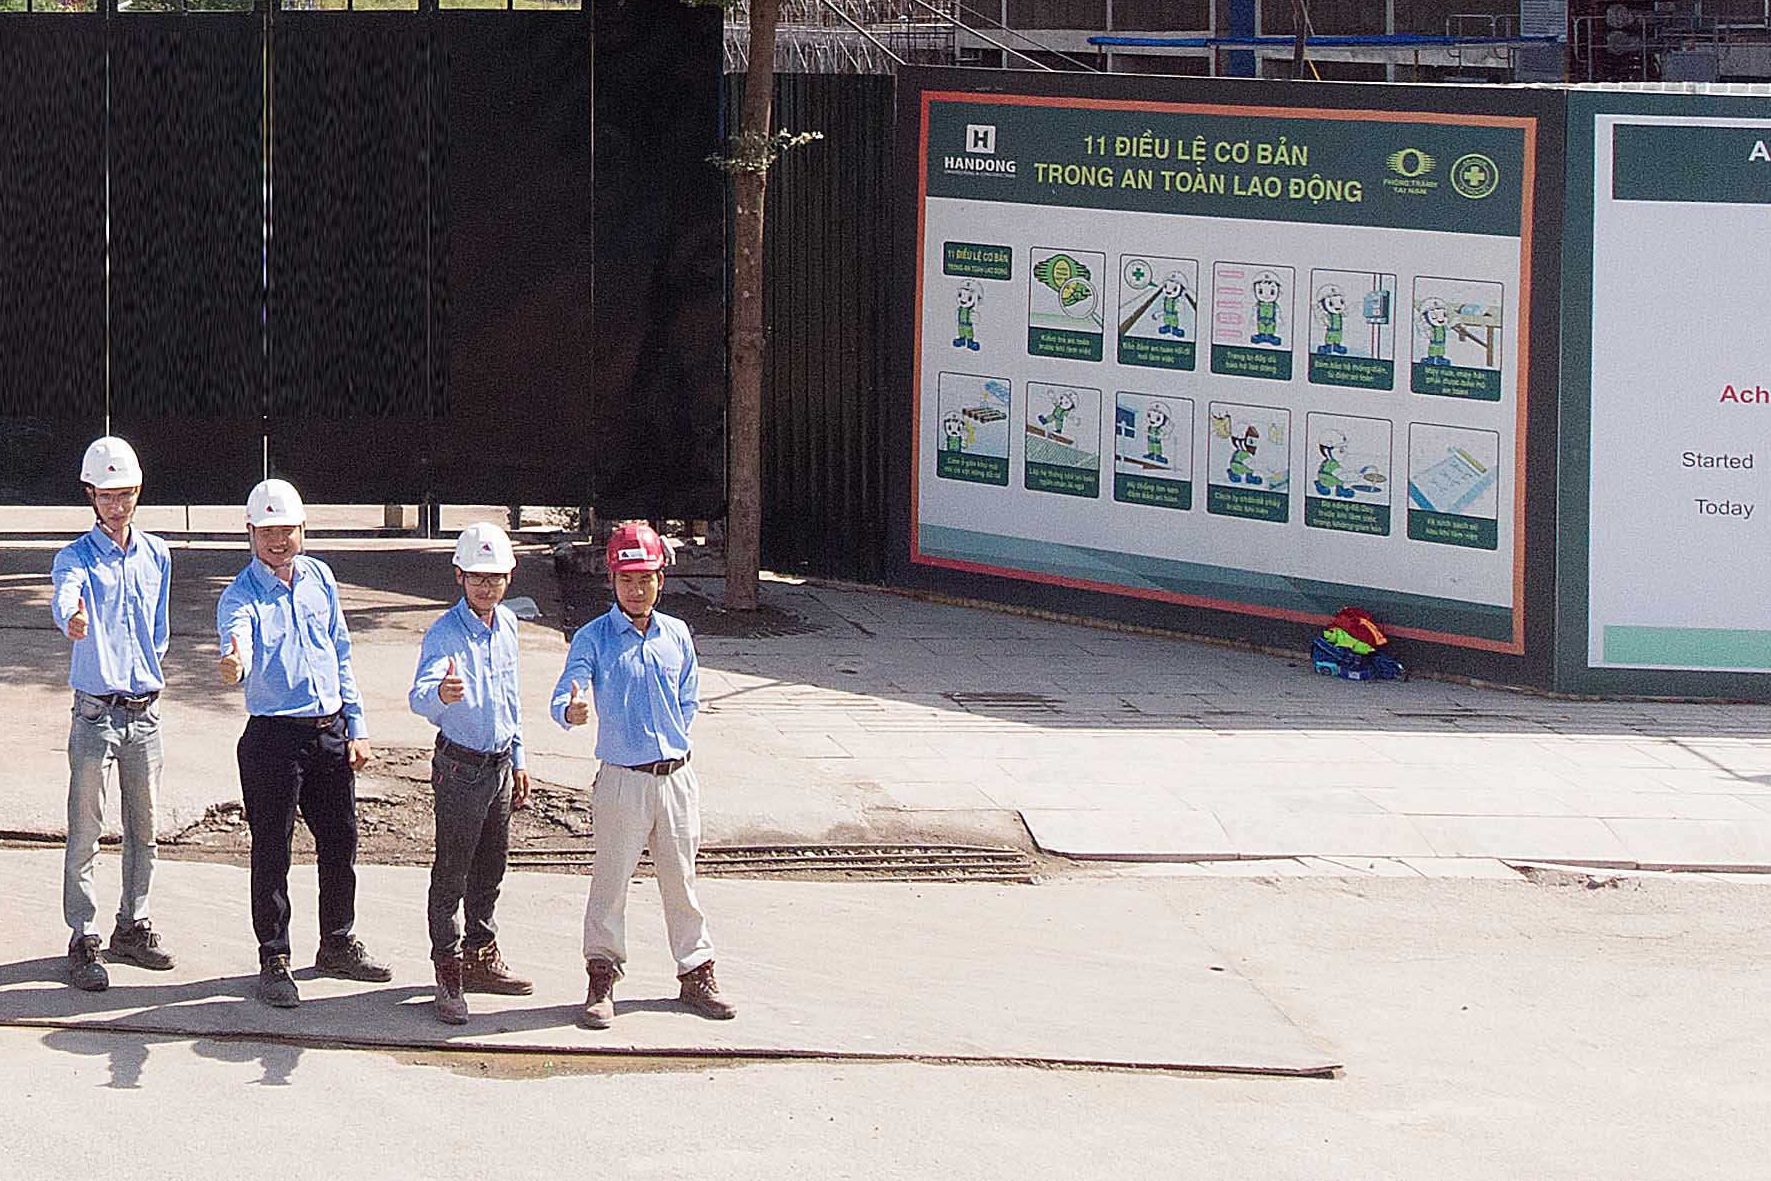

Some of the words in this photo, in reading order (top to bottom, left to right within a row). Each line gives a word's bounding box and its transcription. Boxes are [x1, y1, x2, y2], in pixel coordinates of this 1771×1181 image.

[972, 129, 990, 150] H
[1084, 135, 1106, 156] 11
[1115, 129, 1170, 160] ĐIỀU
[1178, 135, 1206, 165] LỆ
[1214, 140, 1250, 164] CƠ
[1256, 136, 1308, 167] BẢN
[944, 156, 1016, 173] HANDONG
[1034, 162, 1114, 188] TRONG
[1120, 169, 1153, 190] AN
[1161, 168, 1226, 195] TOÀN
[1233, 175, 1282, 198] LAO
[1288, 173, 1363, 205] ĐỘNG
[1681, 451, 1753, 469] Started
[1695, 499, 1754, 520] Today
